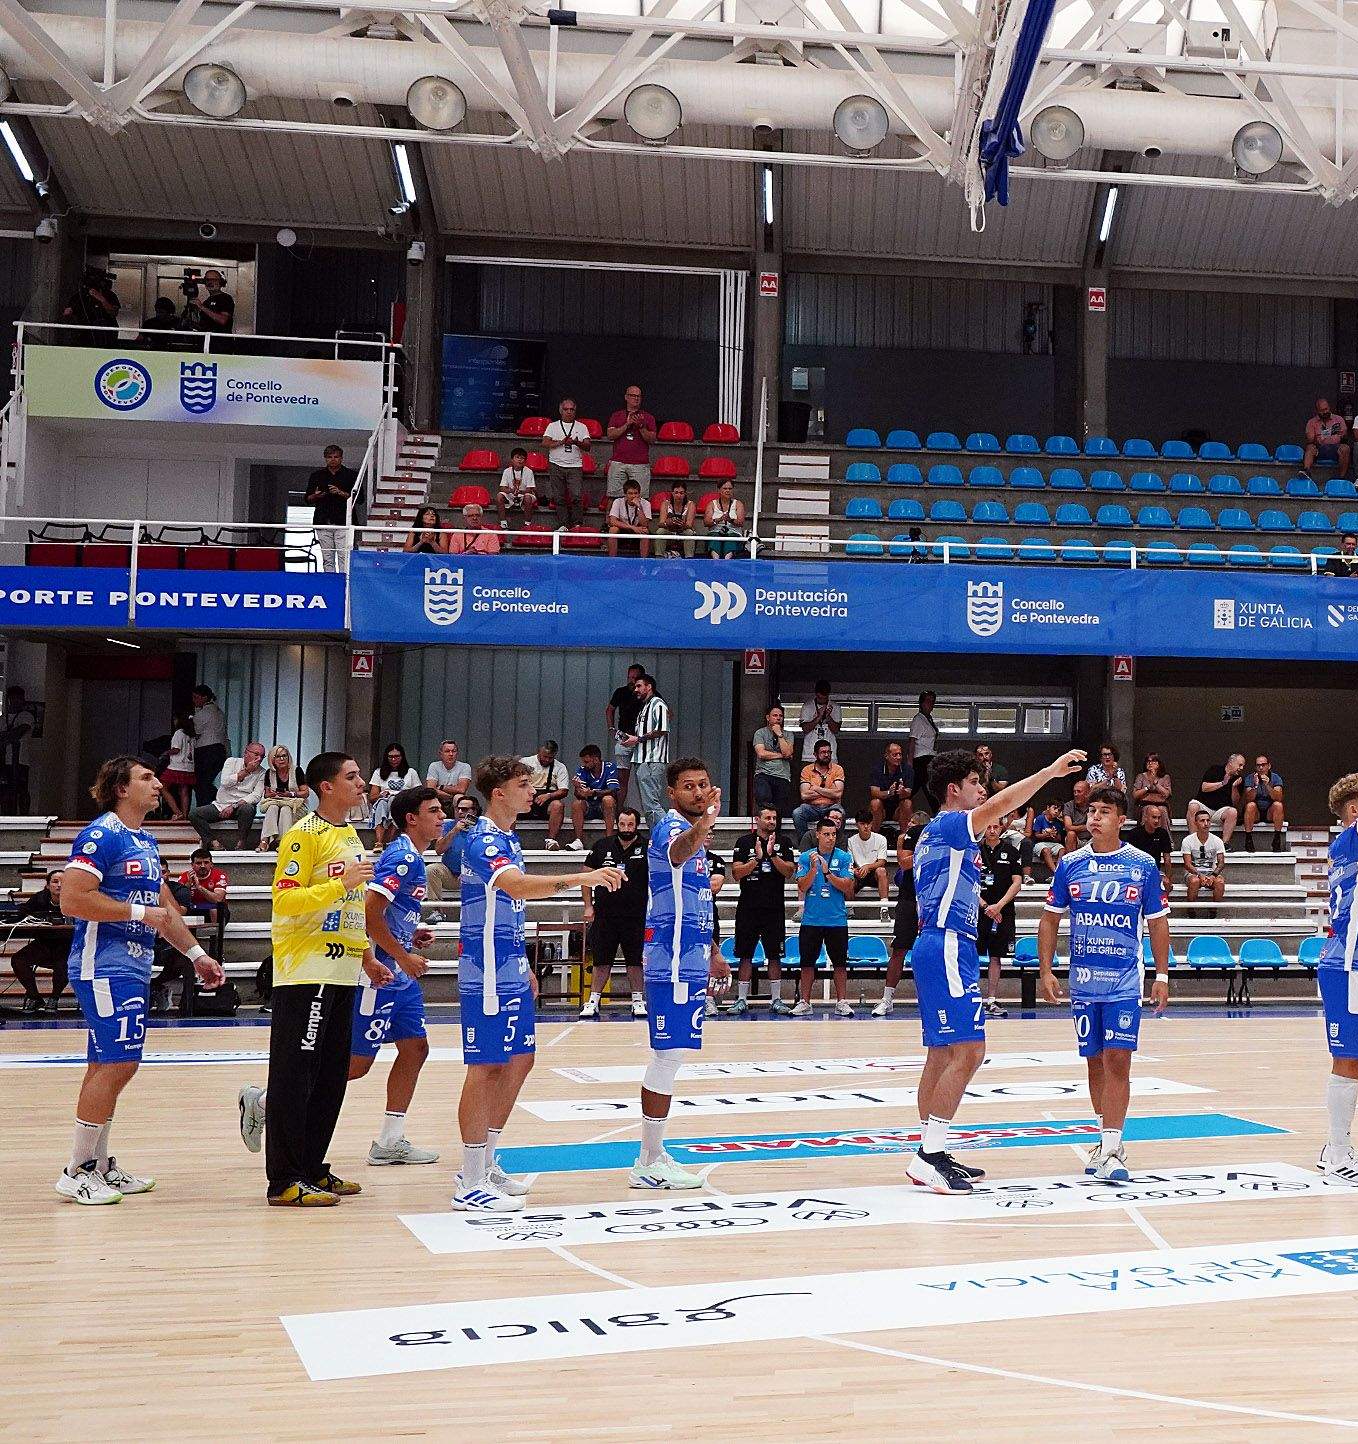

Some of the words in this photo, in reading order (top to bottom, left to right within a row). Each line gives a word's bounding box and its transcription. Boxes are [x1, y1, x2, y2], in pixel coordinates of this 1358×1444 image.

[761, 280, 776, 288] AA
[1090, 295, 1104, 303] AA
[226, 378, 283, 392] Concello
[226, 392, 243, 403] de
[245, 393, 320, 406] Pontevedra
[108, 590, 328, 610] PONTEVEDRA
[472, 584, 532, 600] Concello
[754, 586, 848, 606] Deputación
[472, 600, 491, 612] de
[492, 600, 569, 614] Pontevedra
[754, 603, 848, 618] Pontevedra
[1011, 598, 1065, 611] Concello
[1238, 602, 1285, 616] XUNTA
[1011, 612, 1028, 624] de
[1029, 612, 1100, 625] Pontevedra
[1238, 616, 1257, 629] DE
[1259, 616, 1313, 630] GALICIA
[355, 656, 369, 670] A
[1098, 862, 1125, 872] ence
[1087, 880, 1121, 904] 10
[1076, 912, 1132, 929] ABANCA
[971, 996, 983, 1022] 7
[114, 1013, 145, 1042] 15
[300, 1001, 323, 1051] Kempa
[503, 1015, 519, 1043] 5
[684, 1124, 1101, 1154] PESCAMAR
[465, 1197, 848, 1226] Vepersa
[1189, 1258, 1274, 1269] DE
[915, 1266, 1174, 1291] GALICIA
[1081, 1267, 1302, 1292] XUNTA
[388, 1292, 812, 1346] galicia
